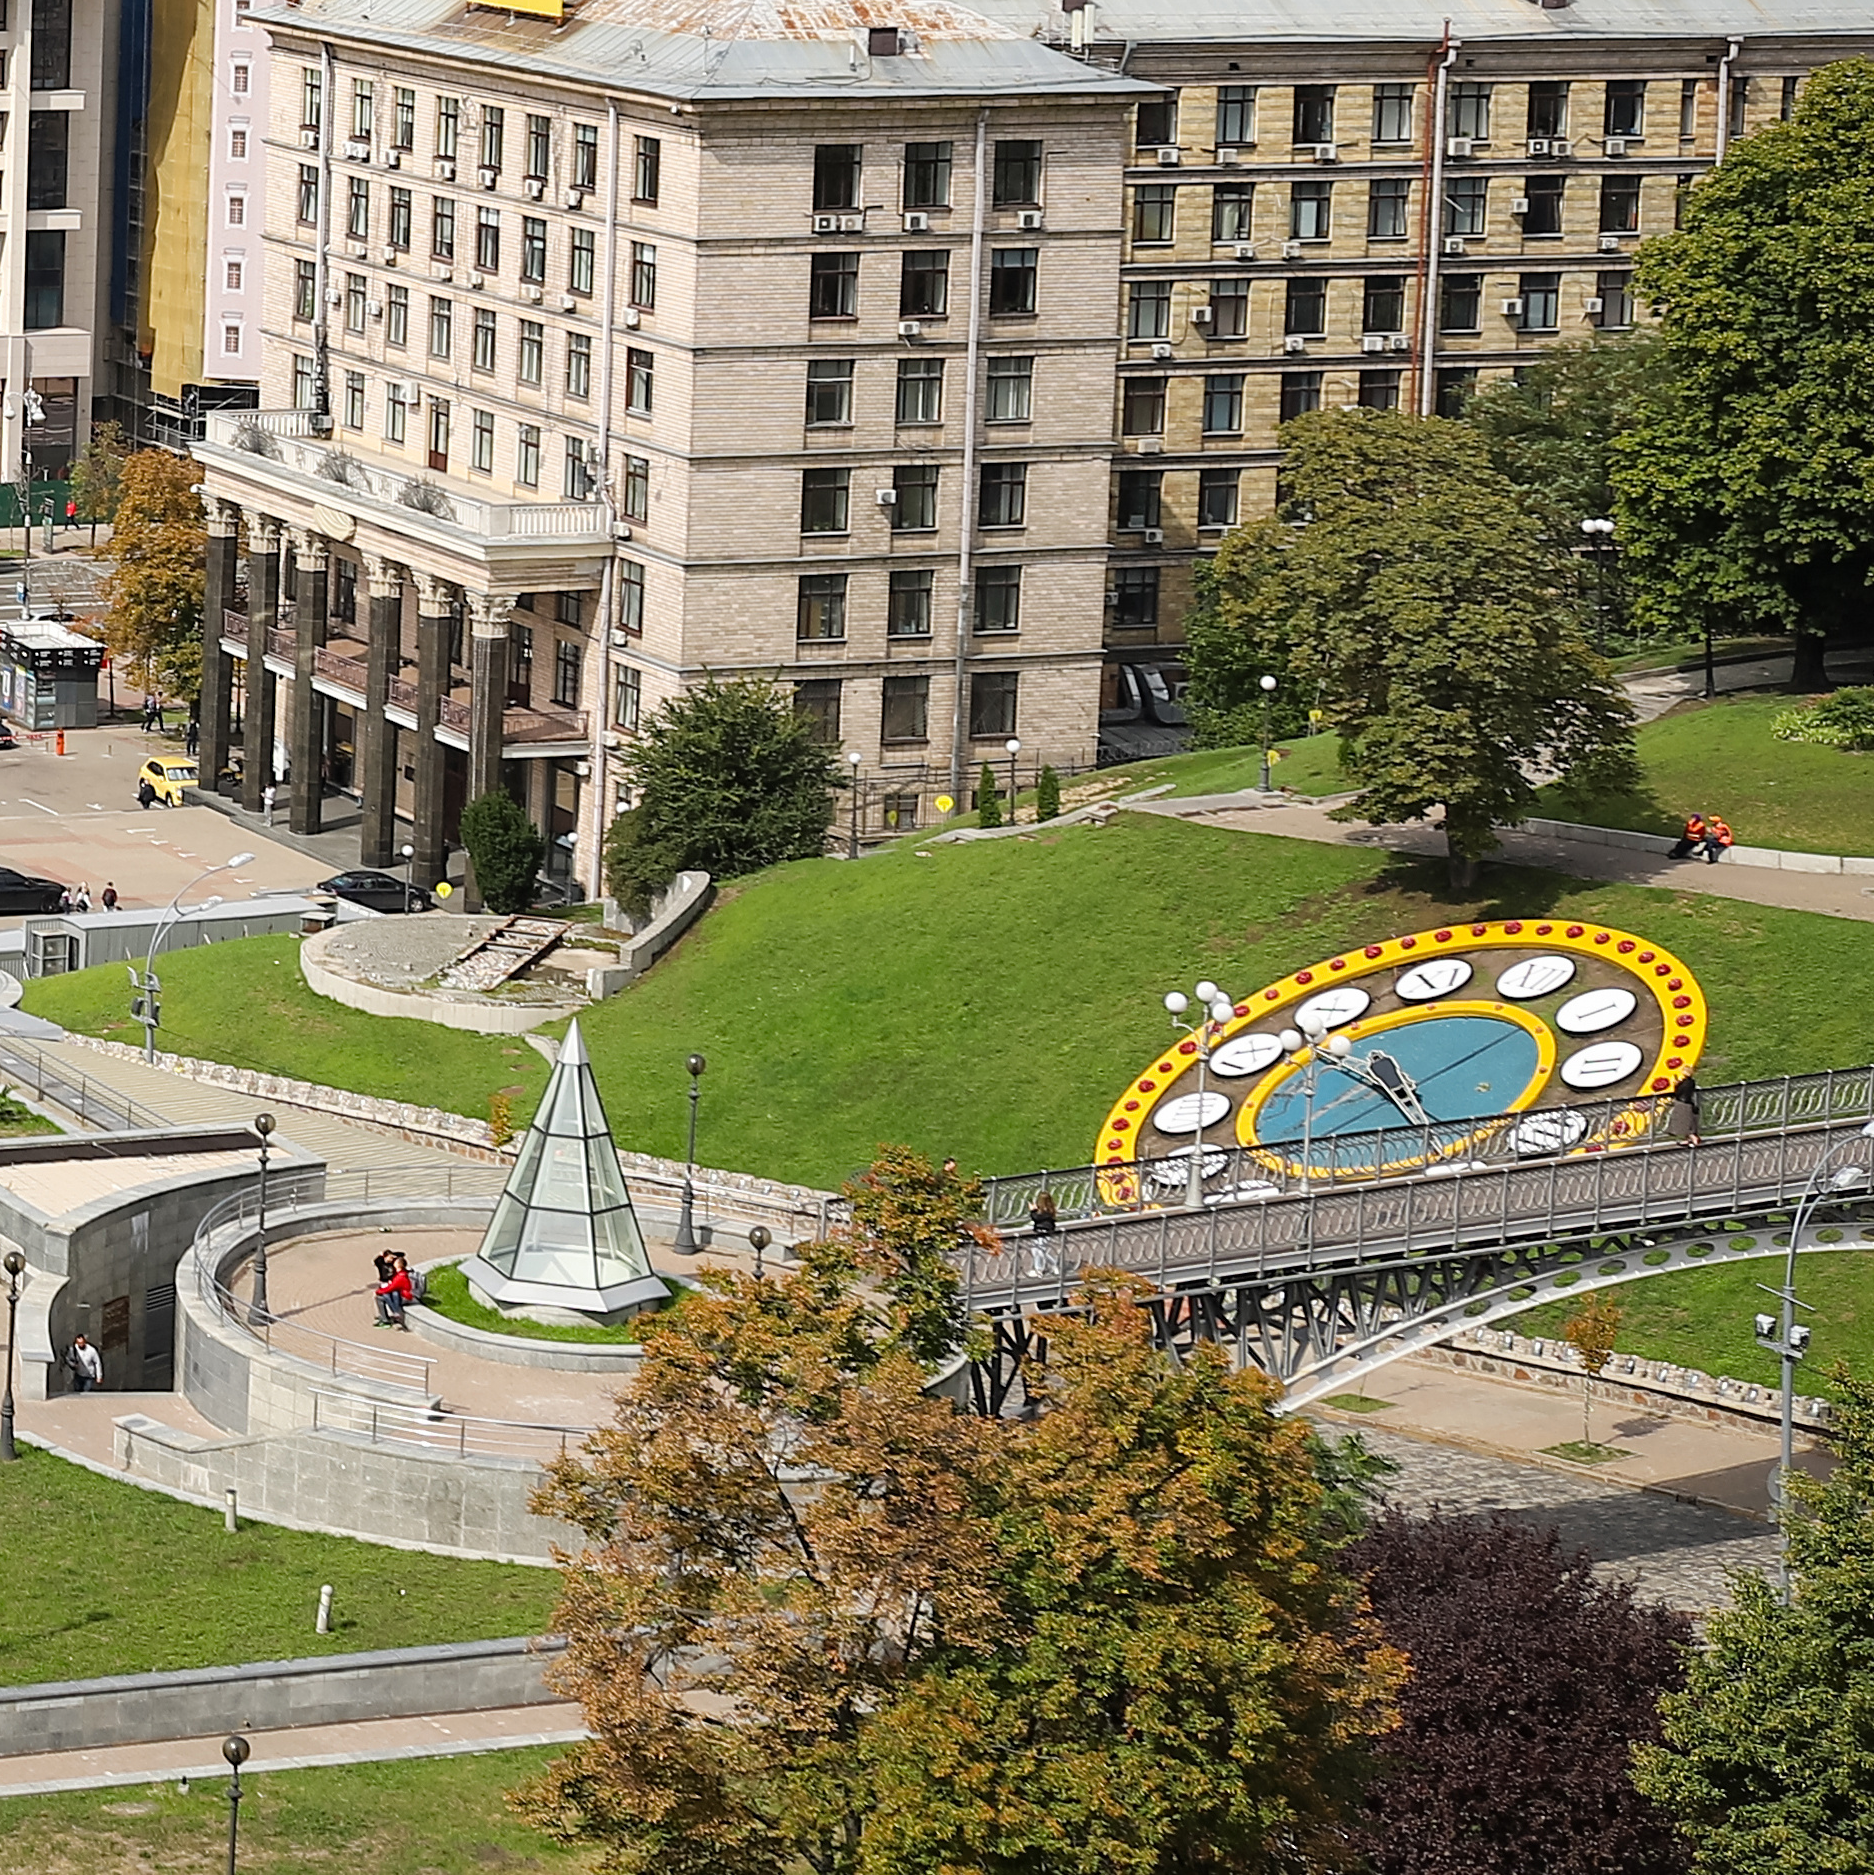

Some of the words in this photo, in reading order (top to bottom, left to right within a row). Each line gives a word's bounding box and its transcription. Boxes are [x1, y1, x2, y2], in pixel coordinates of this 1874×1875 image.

[1406, 968, 1464, 994] XI
[1506, 963, 1568, 991] XII
[1313, 995, 1355, 1022] X
[1576, 1002, 1618, 1020] I
[1219, 1038, 1276, 1071] IX
[1579, 1055, 1624, 1077] II
